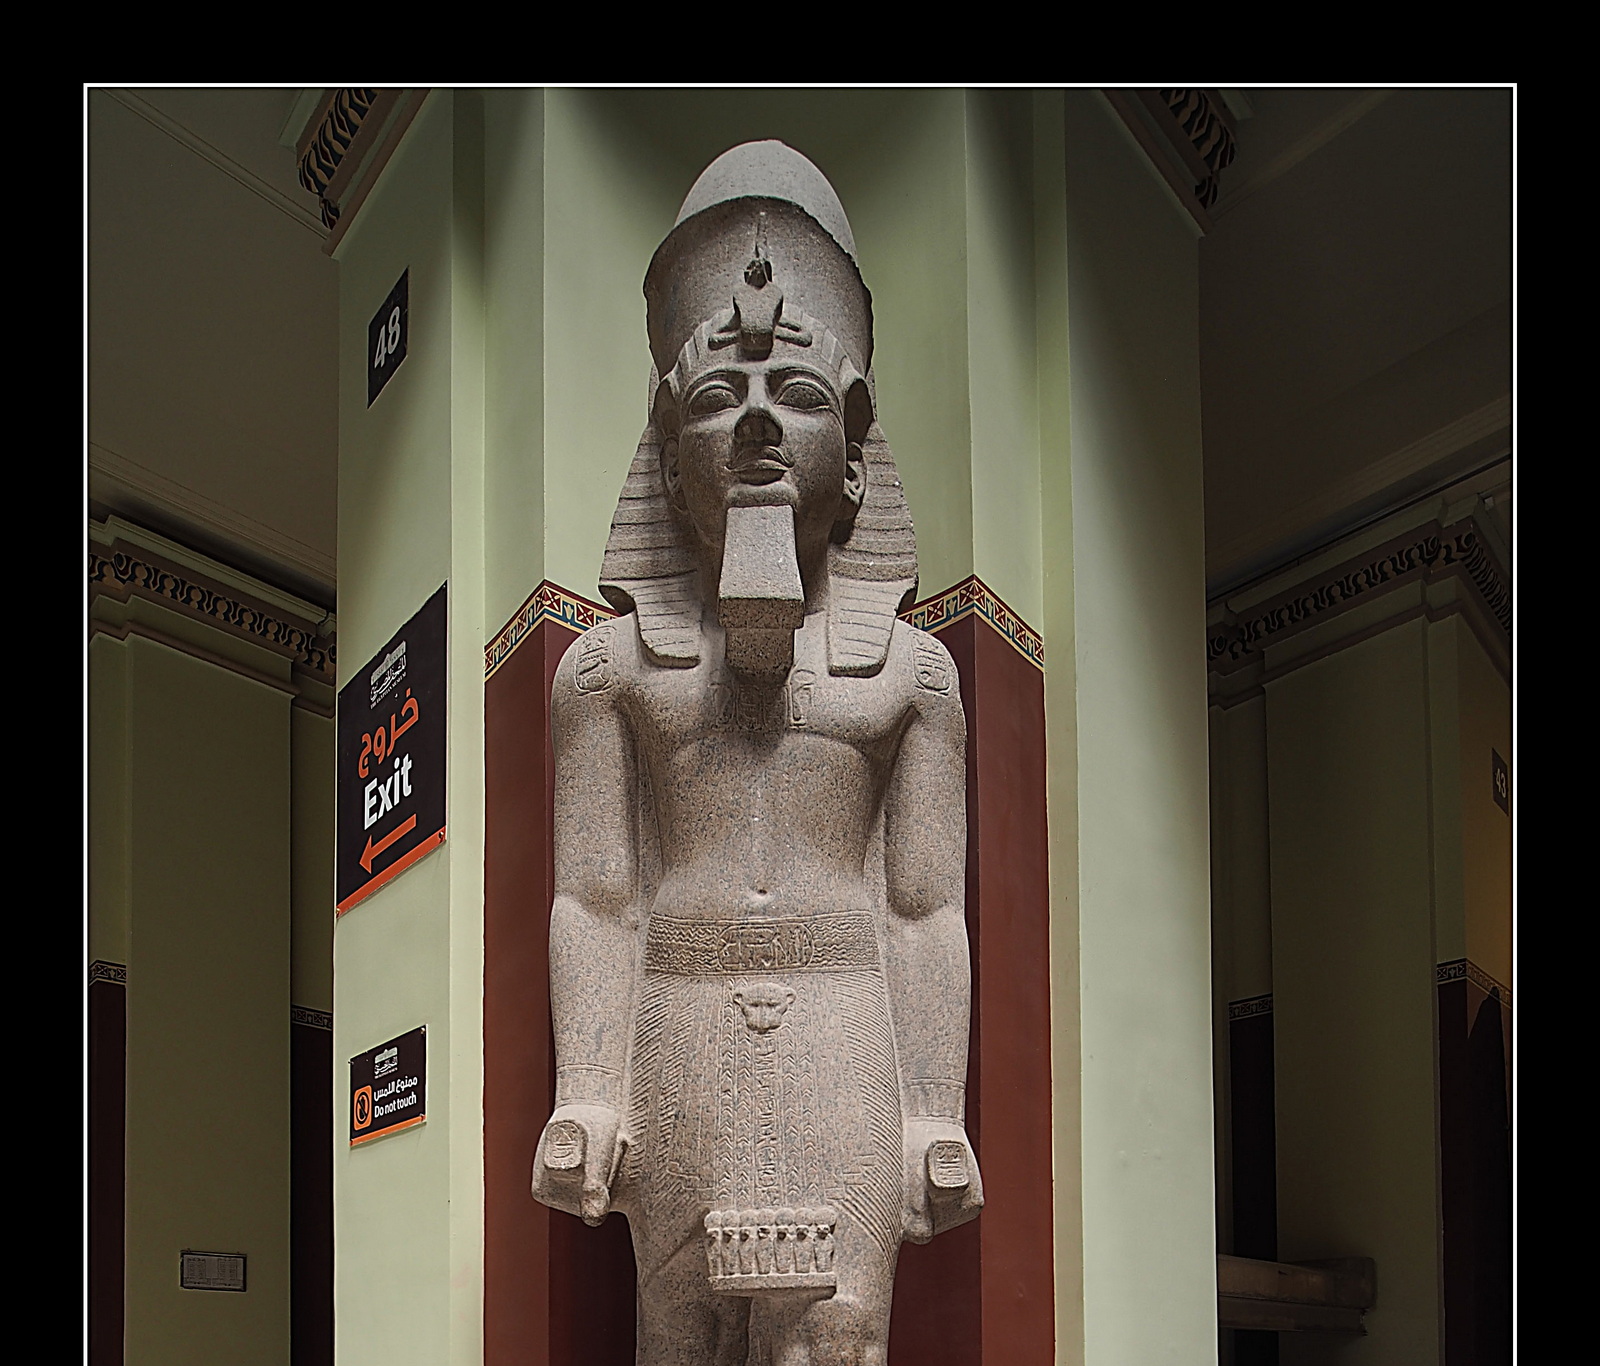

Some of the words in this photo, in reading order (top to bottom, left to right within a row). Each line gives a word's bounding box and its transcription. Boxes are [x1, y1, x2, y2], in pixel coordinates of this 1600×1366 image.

[374, 306, 400, 369] 48
[358, 687, 419, 779] خروج
[364, 753, 412, 831] Exit
[1495, 767, 1507, 799] 43
[373, 1081, 396, 1102] اللمس
[395, 1076, 418, 1094] ممنوع
[374, 1105, 385, 1118] Do
[384, 1099, 397, 1115] not
[397, 1091, 417, 1109] touch
